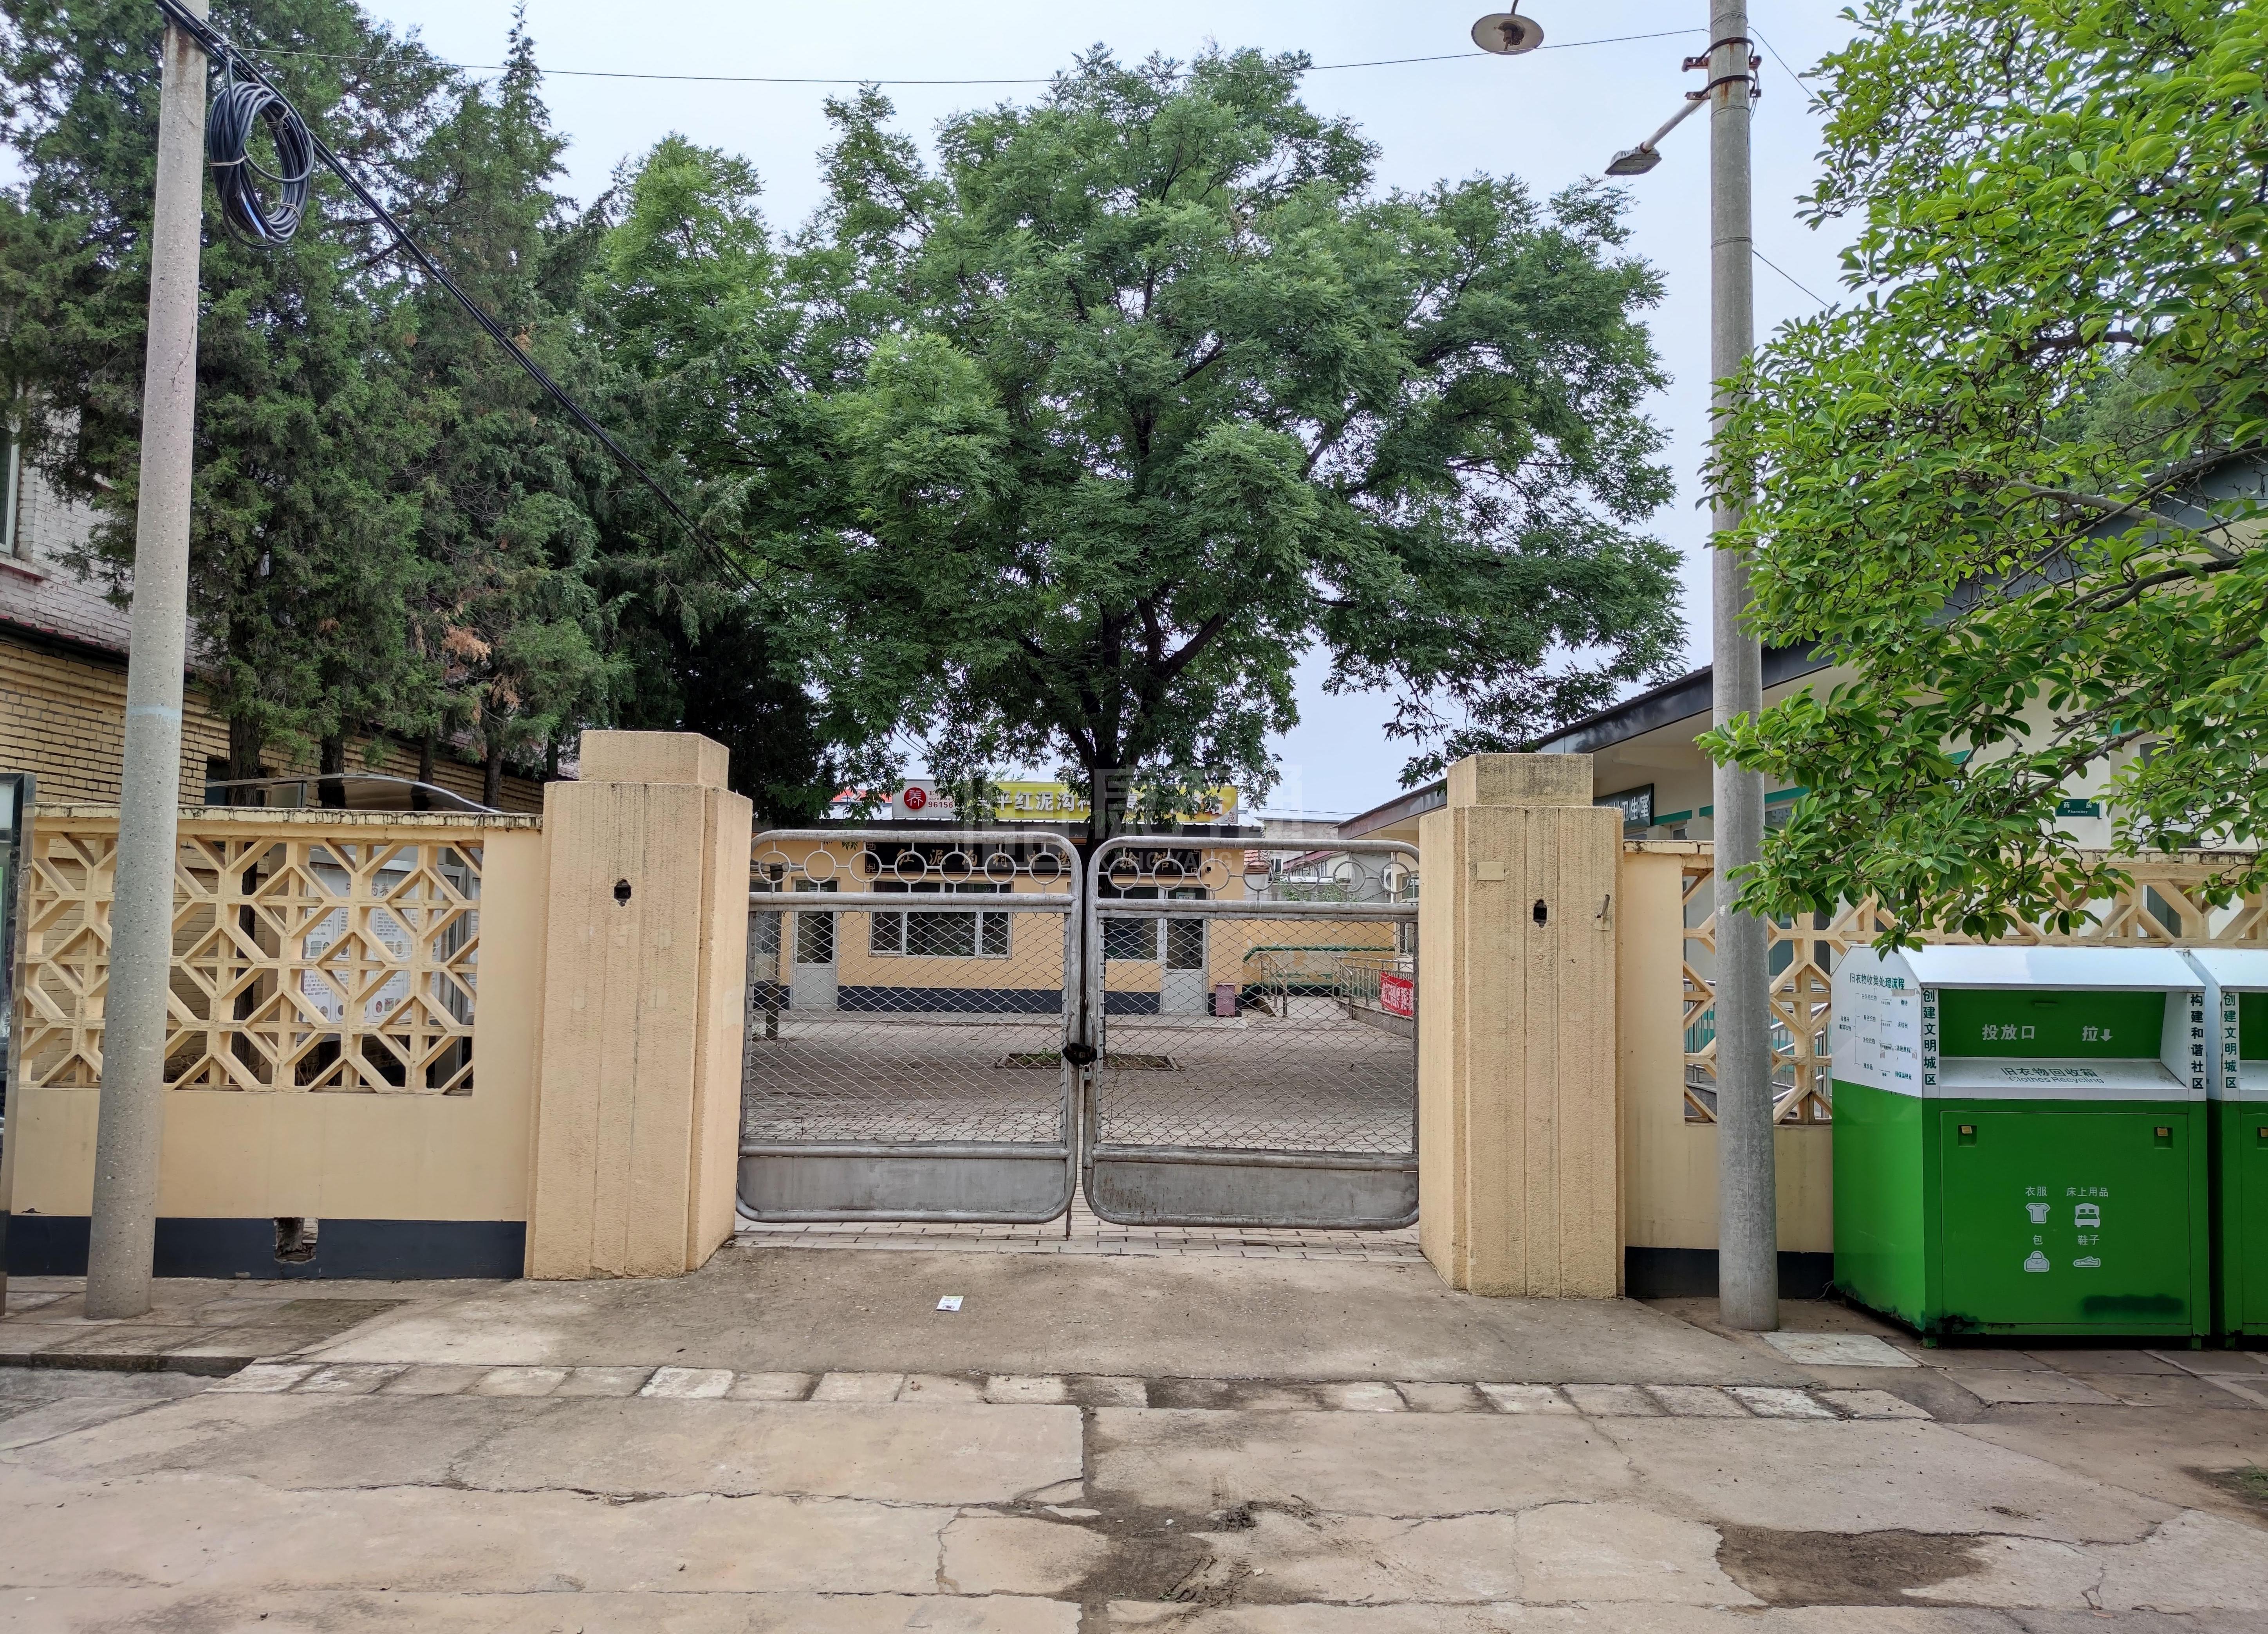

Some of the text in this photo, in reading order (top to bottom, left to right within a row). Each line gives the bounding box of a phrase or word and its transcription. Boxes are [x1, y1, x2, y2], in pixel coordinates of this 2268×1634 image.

[1850, 972, 1905, 990] 旧衣物收集处理流程
[1923, 989, 1936, 1085] 创建文明城区
[1982, 1024, 2035, 1041] 投放口
[2082, 1026, 2099, 1041] 拉
[2190, 994, 2204, 1089] 构建和谐社区
[2223, 993, 2237, 1088] 创建文明城区
[2001, 1068, 2099, 1077] 旧衣物回收箱
[2025, 1186, 2048, 1197] 衣服
[2066, 1187, 2109, 1198] 床上用品
[2032, 1234, 2043, 1245] 包
[2077, 1235, 2100, 1246] 鞋子
